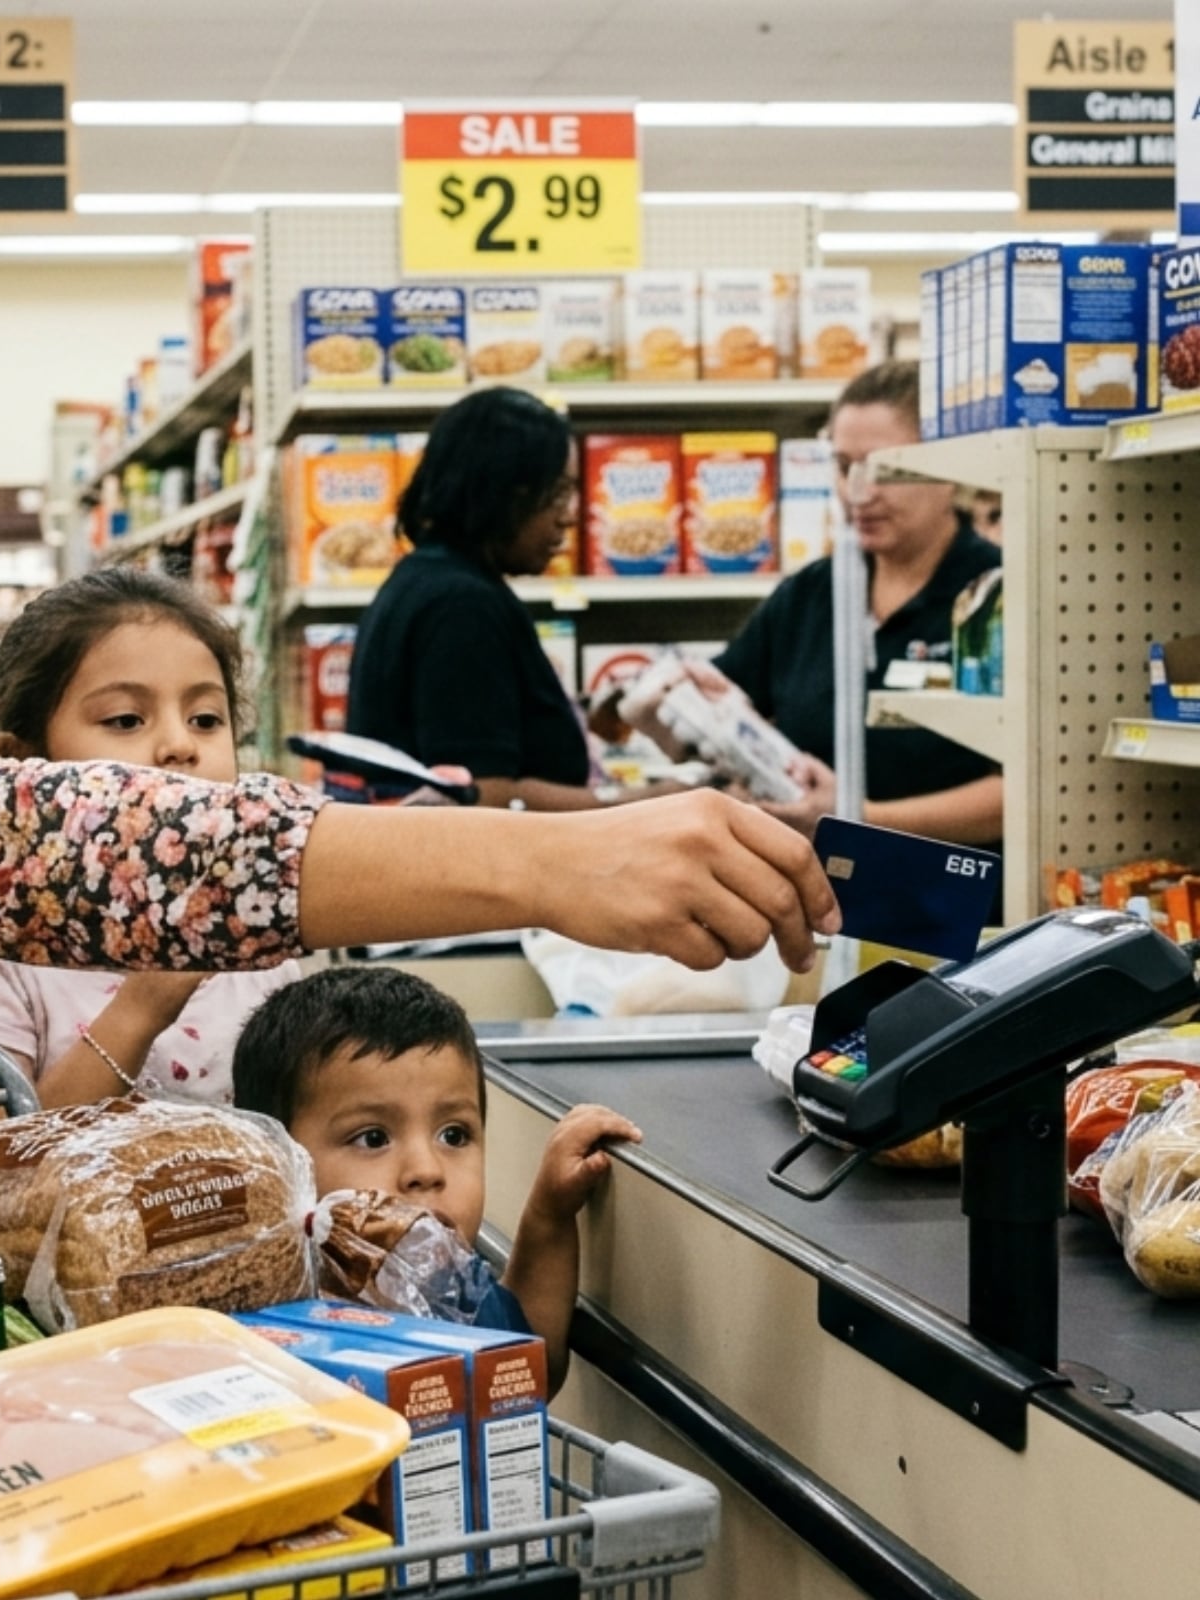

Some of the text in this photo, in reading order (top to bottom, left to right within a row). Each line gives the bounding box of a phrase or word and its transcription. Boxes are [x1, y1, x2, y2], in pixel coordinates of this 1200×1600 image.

[1047, 37, 1148, 73] Aisle
[459, 115, 581, 156] SALE
[1031, 134, 1137, 165] General
[944, 854, 994, 880] EBT
